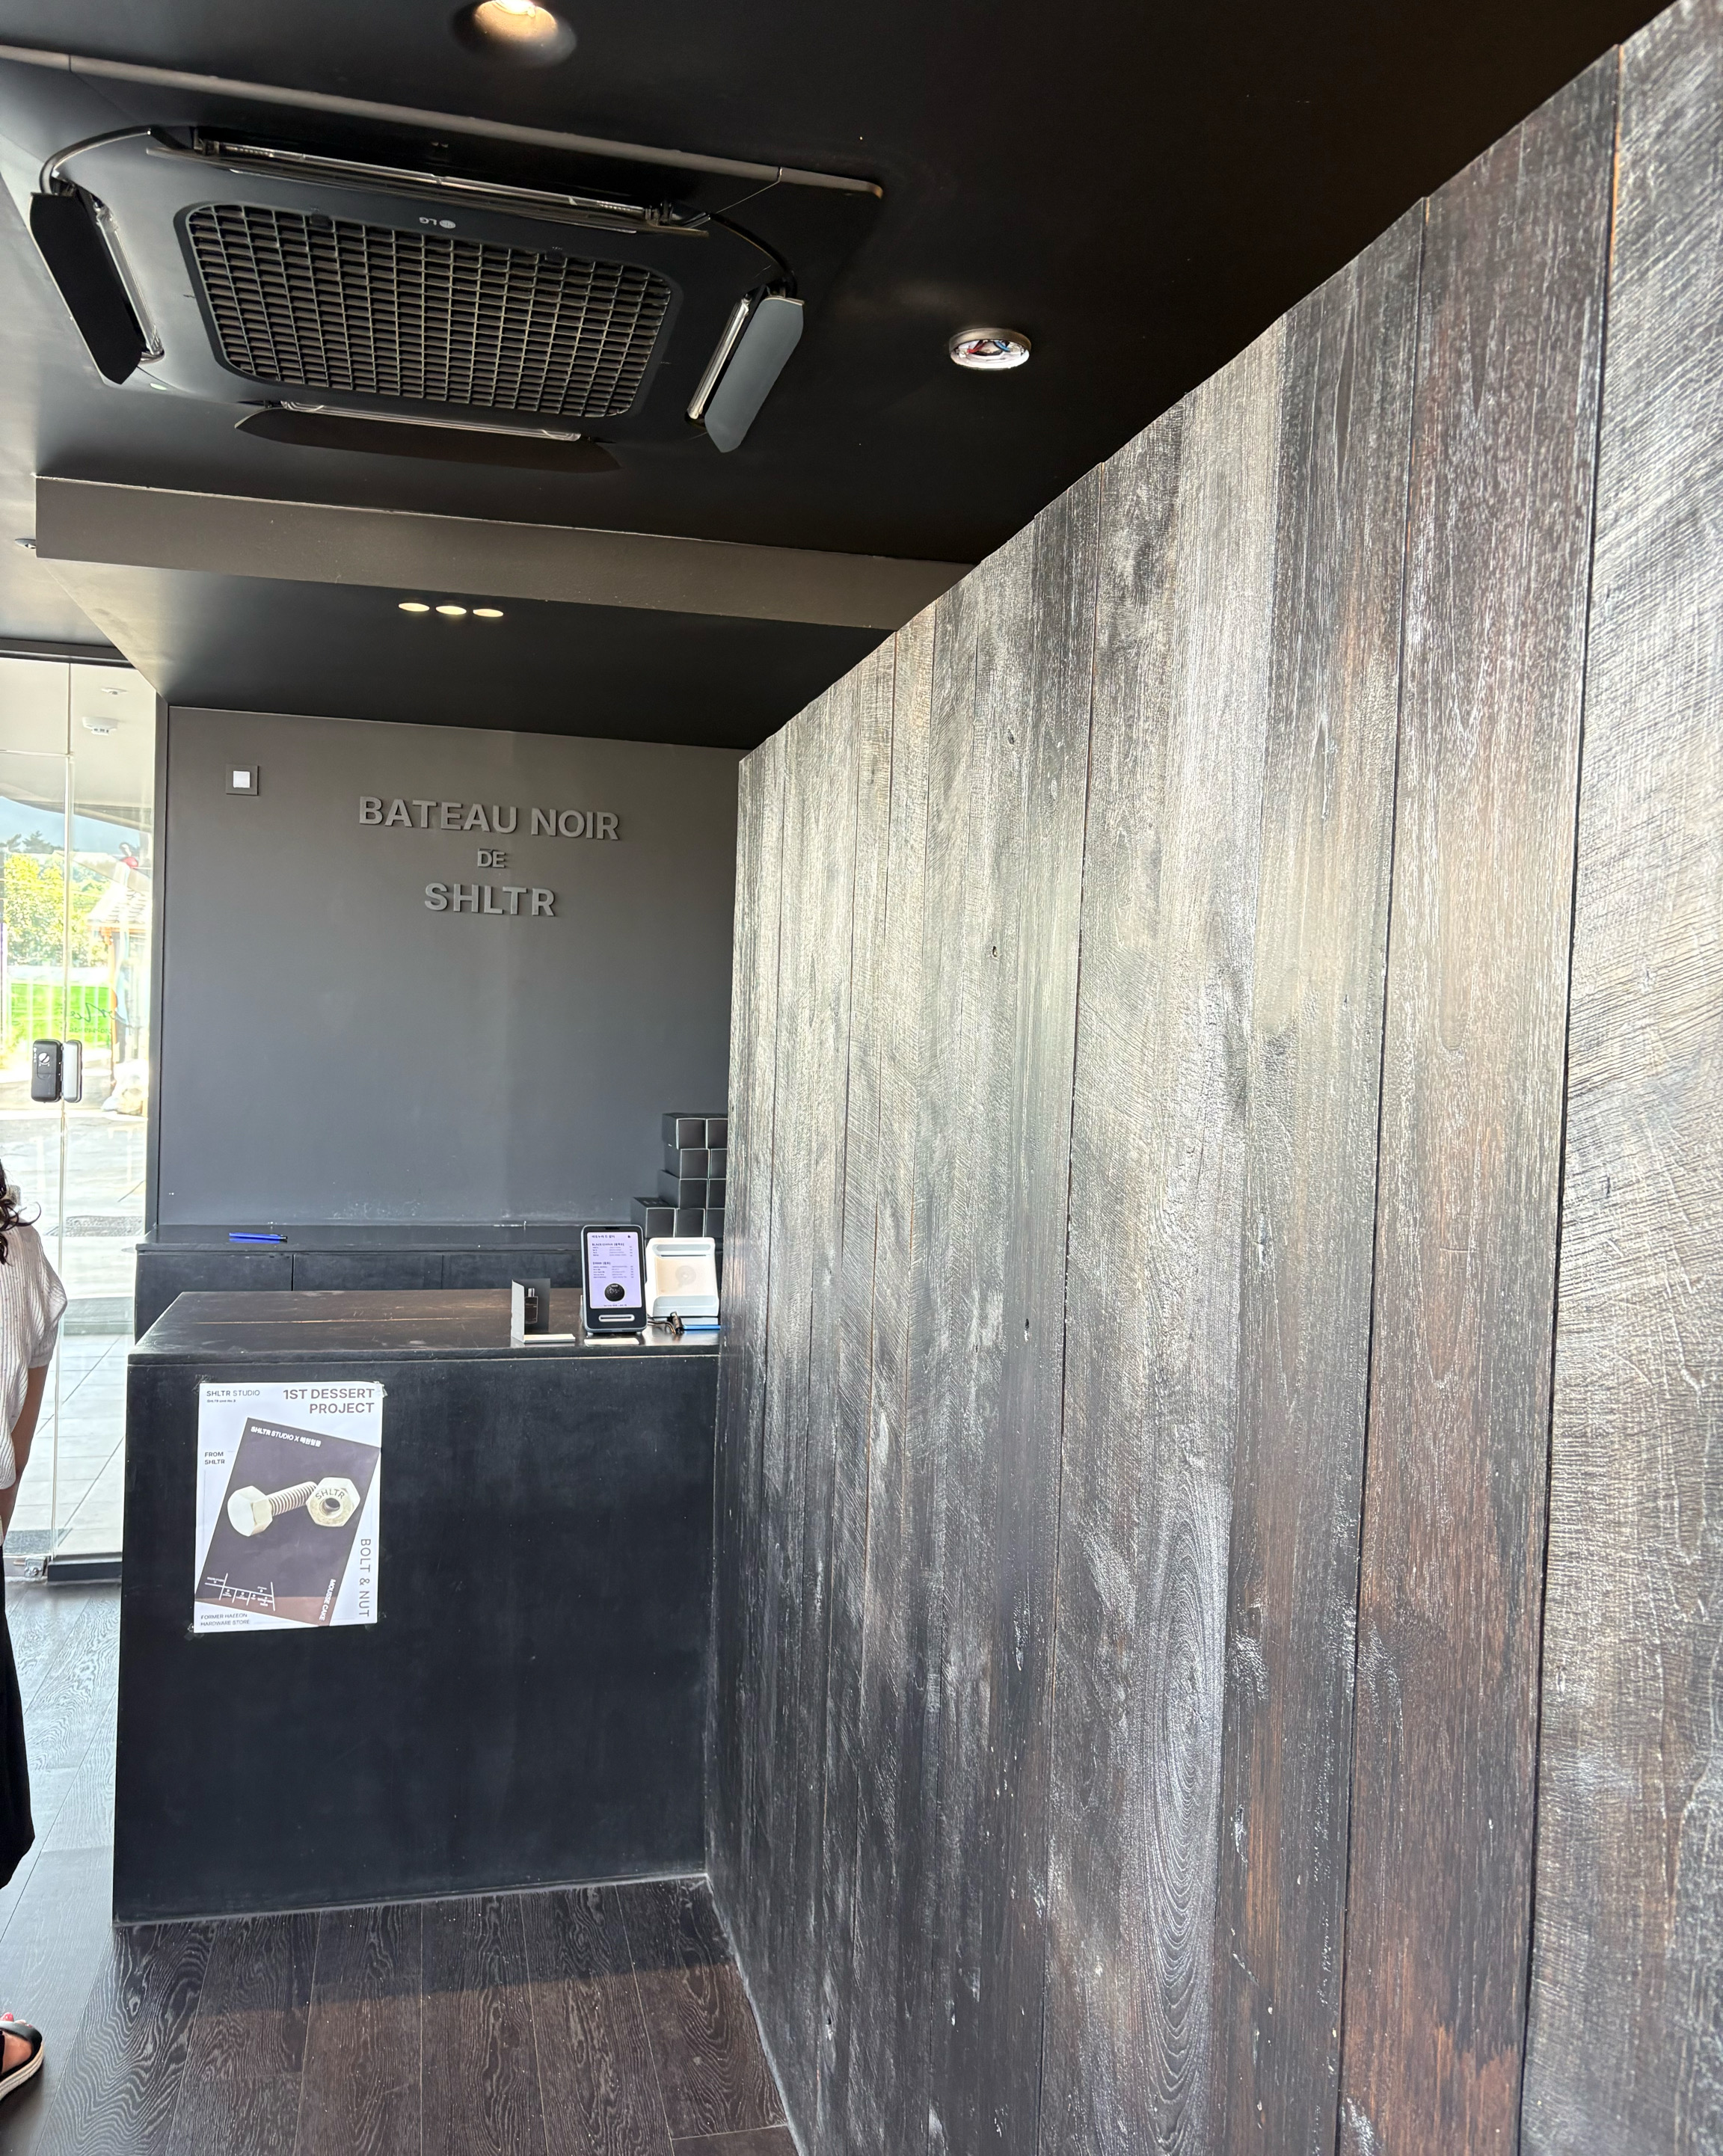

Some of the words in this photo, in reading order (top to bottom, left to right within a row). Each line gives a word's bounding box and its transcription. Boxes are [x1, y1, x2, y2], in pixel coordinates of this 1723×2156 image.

[359, 796, 518, 834] BATEAU
[531, 808, 619, 840] NOIR
[477, 849, 506, 868] DE
[424, 882, 555, 916] SHLTR
[283, 1389, 308, 1399] 1ST
[310, 1388, 375, 1399] DESSERT
[309, 1402, 375, 1413] PROJECT
[251, 1426, 271, 1436] SHLTR
[271, 1431, 294, 1441] STUDIO
[315, 1487, 345, 1500] SHLTR
[360, 1538, 372, 1573] BOLT
[359, 1577, 370, 1585] &
[324, 1579, 336, 1605] MOUSSE
[358, 1591, 370, 1617] NUT
[319, 1605, 329, 1621] CAKE
